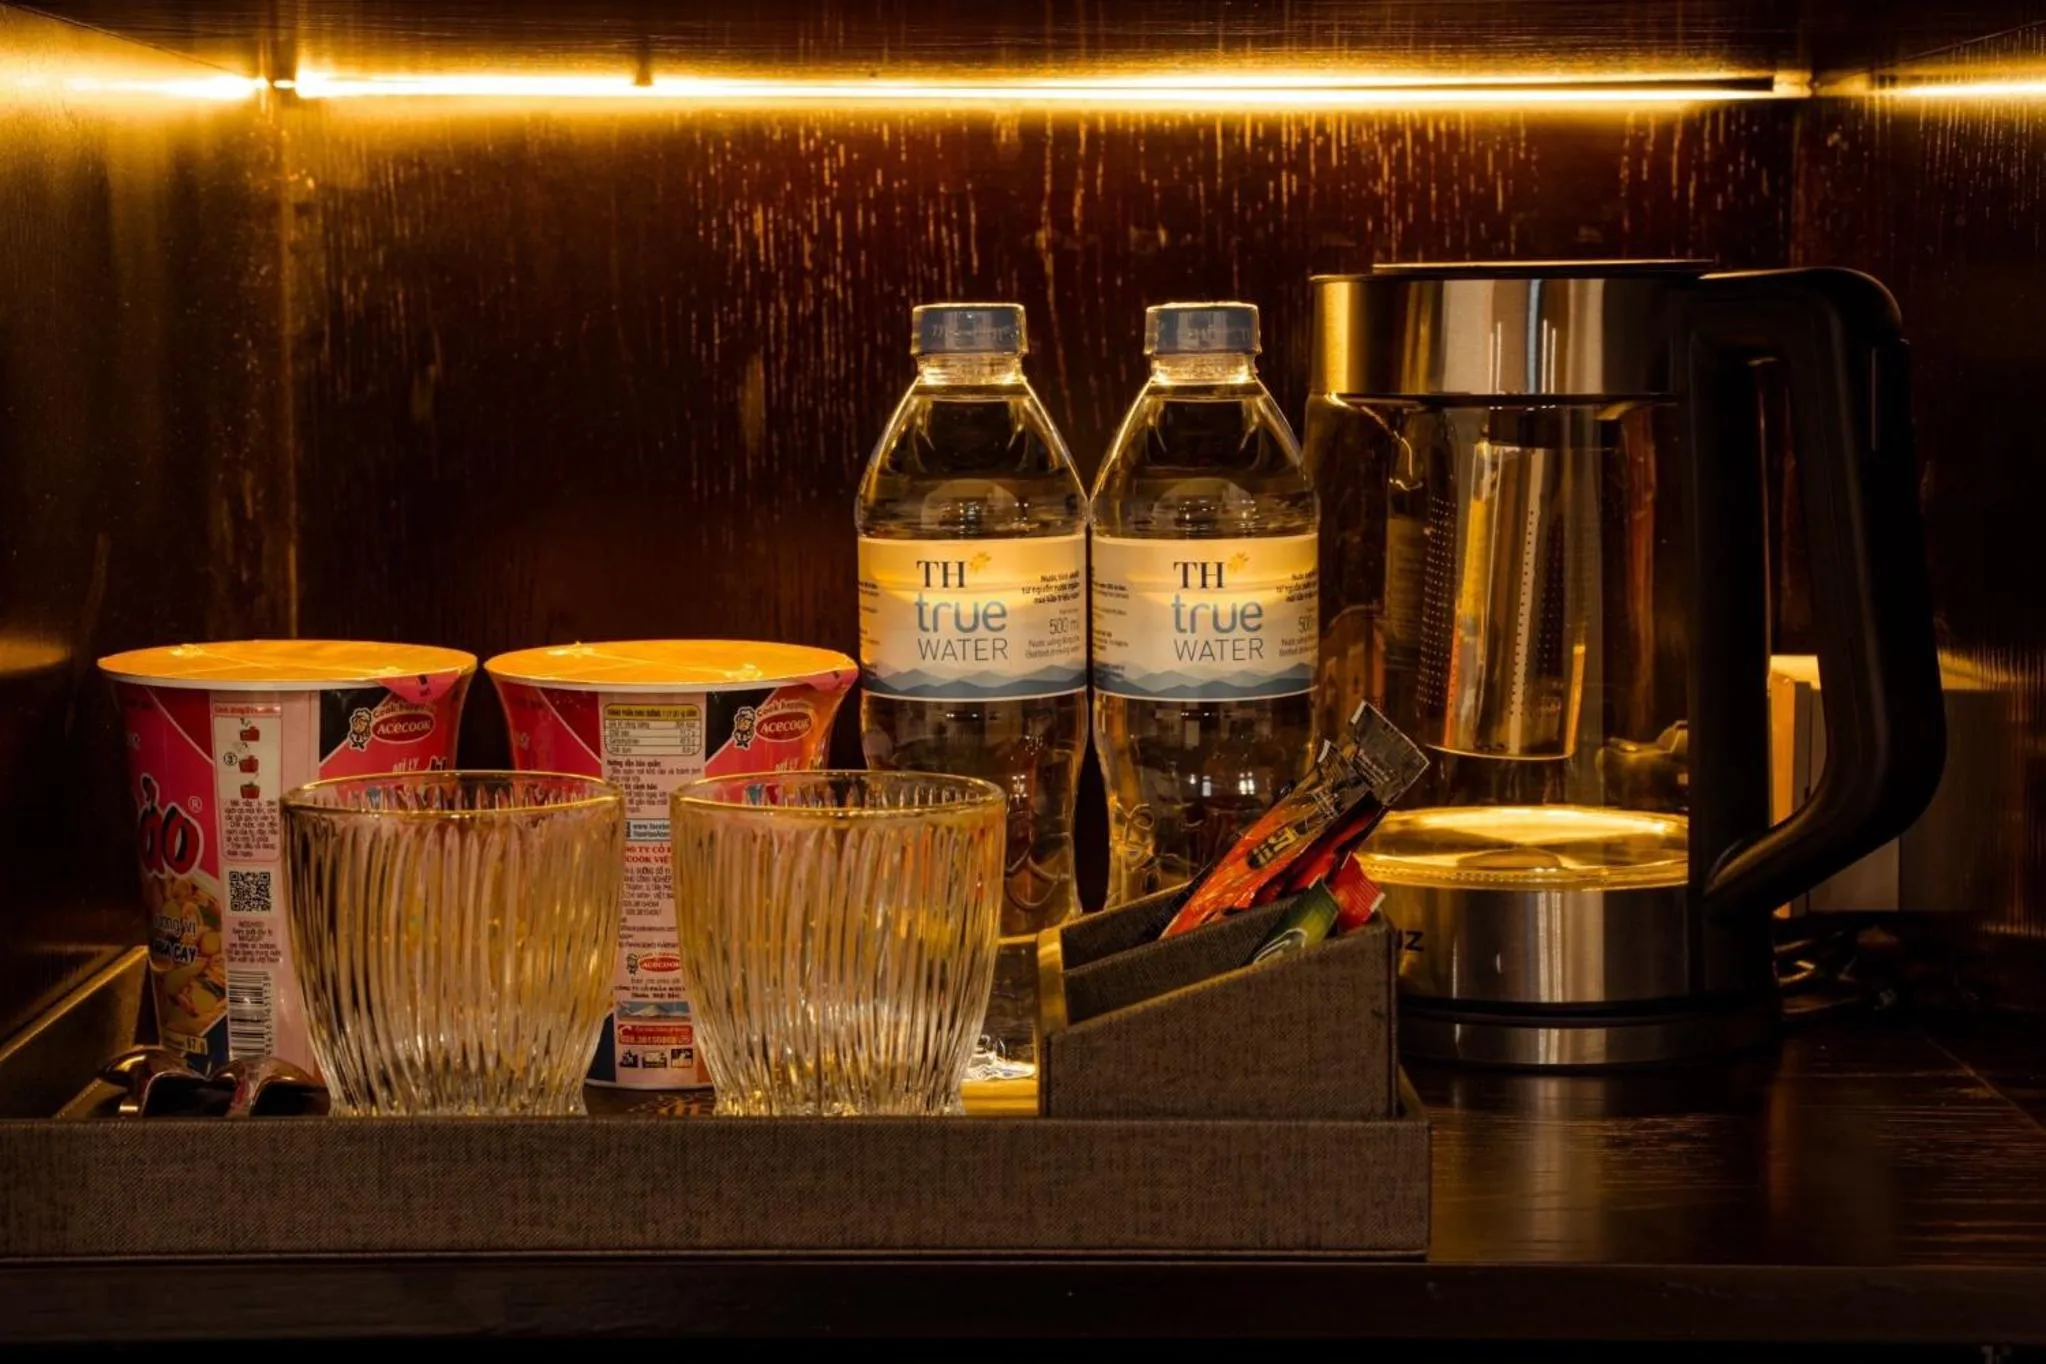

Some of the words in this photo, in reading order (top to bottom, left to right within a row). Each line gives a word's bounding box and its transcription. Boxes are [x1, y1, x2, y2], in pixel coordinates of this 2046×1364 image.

[916, 560, 965, 588] TH
[1173, 561, 1224, 589] TH
[915, 592, 1008, 633] true
[1171, 592, 1264, 634] true
[917, 638, 1009, 661] WATER
[1173, 638, 1264, 661] WATER
